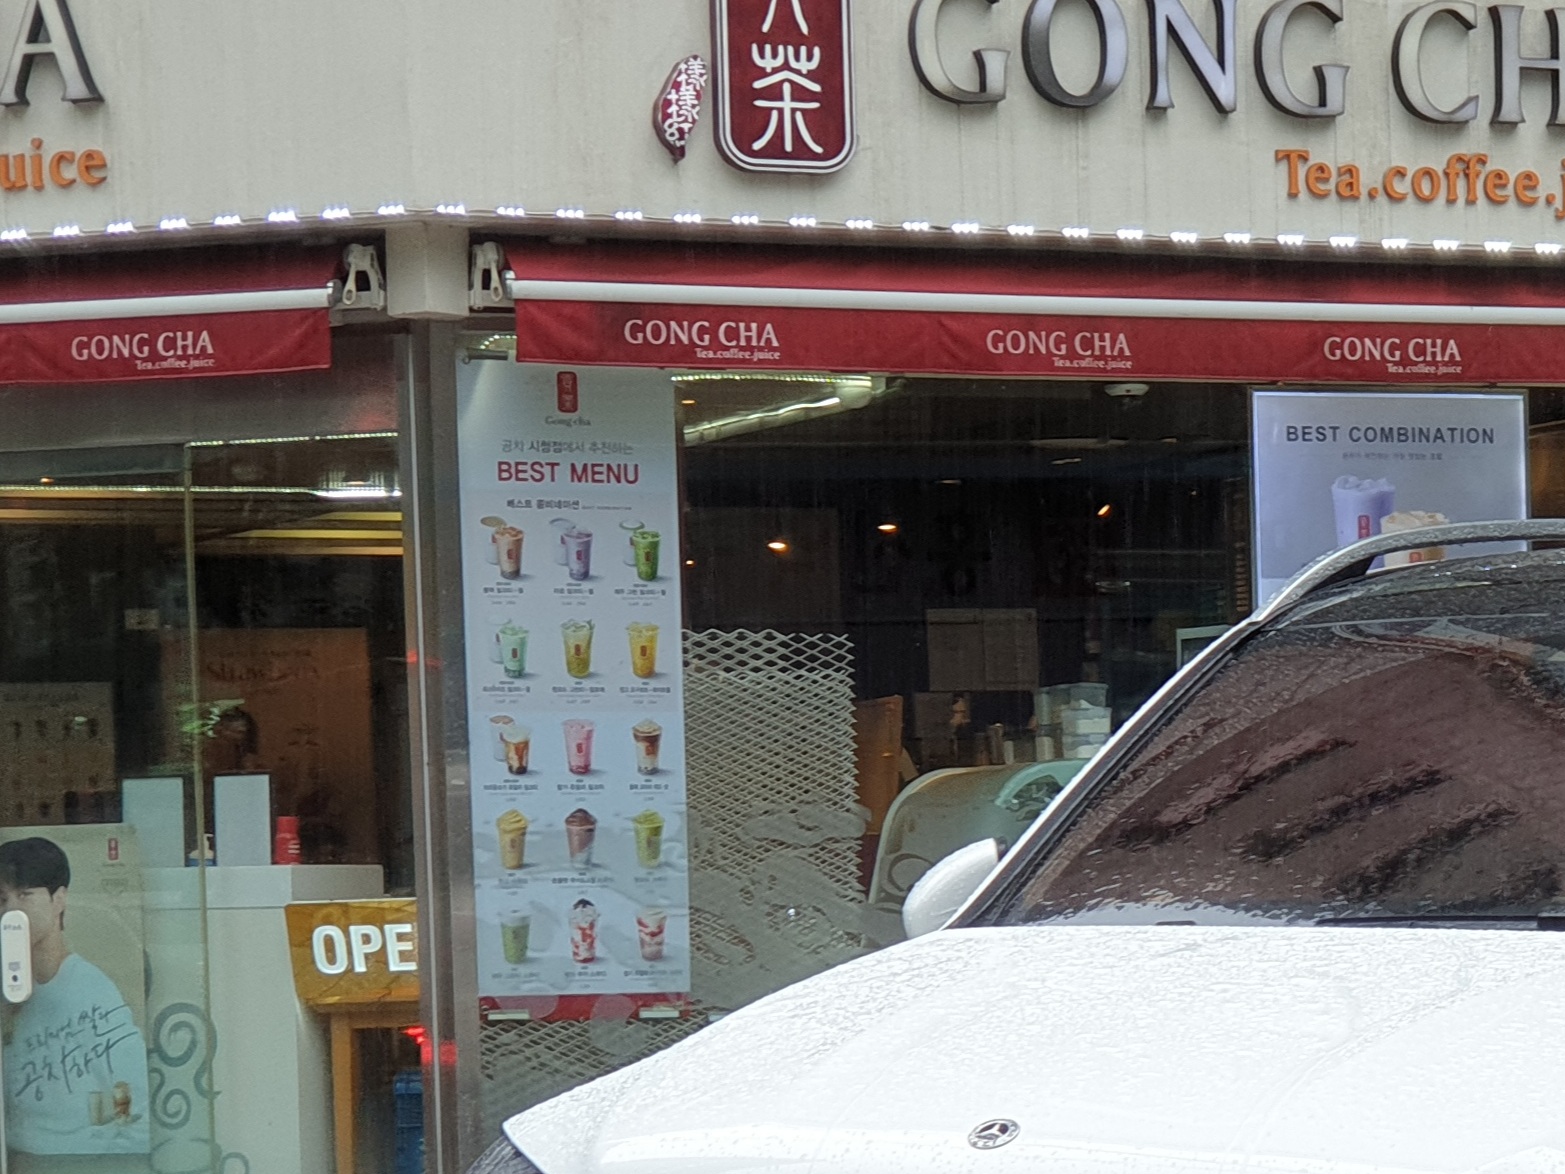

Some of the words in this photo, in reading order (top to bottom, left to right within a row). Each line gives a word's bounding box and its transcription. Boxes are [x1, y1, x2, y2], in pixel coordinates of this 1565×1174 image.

[908, 0, 1351, 118] GONG
[71, 333, 149, 361] GONG
[157, 330, 214, 357] CHA
[624, 319, 711, 346] GONG
[718, 322, 780, 347] CHA
[986, 329, 1067, 355] GONG
[1074, 332, 1131, 356] CHA
[1323, 337, 1401, 361] GONG
[1408, 338, 1462, 362] CHA
[1286, 425, 1341, 443] BEST
[1348, 426, 1495, 445] COMBINATION
[497, 461, 560, 483] BEST
[570, 462, 640, 485] MENU
